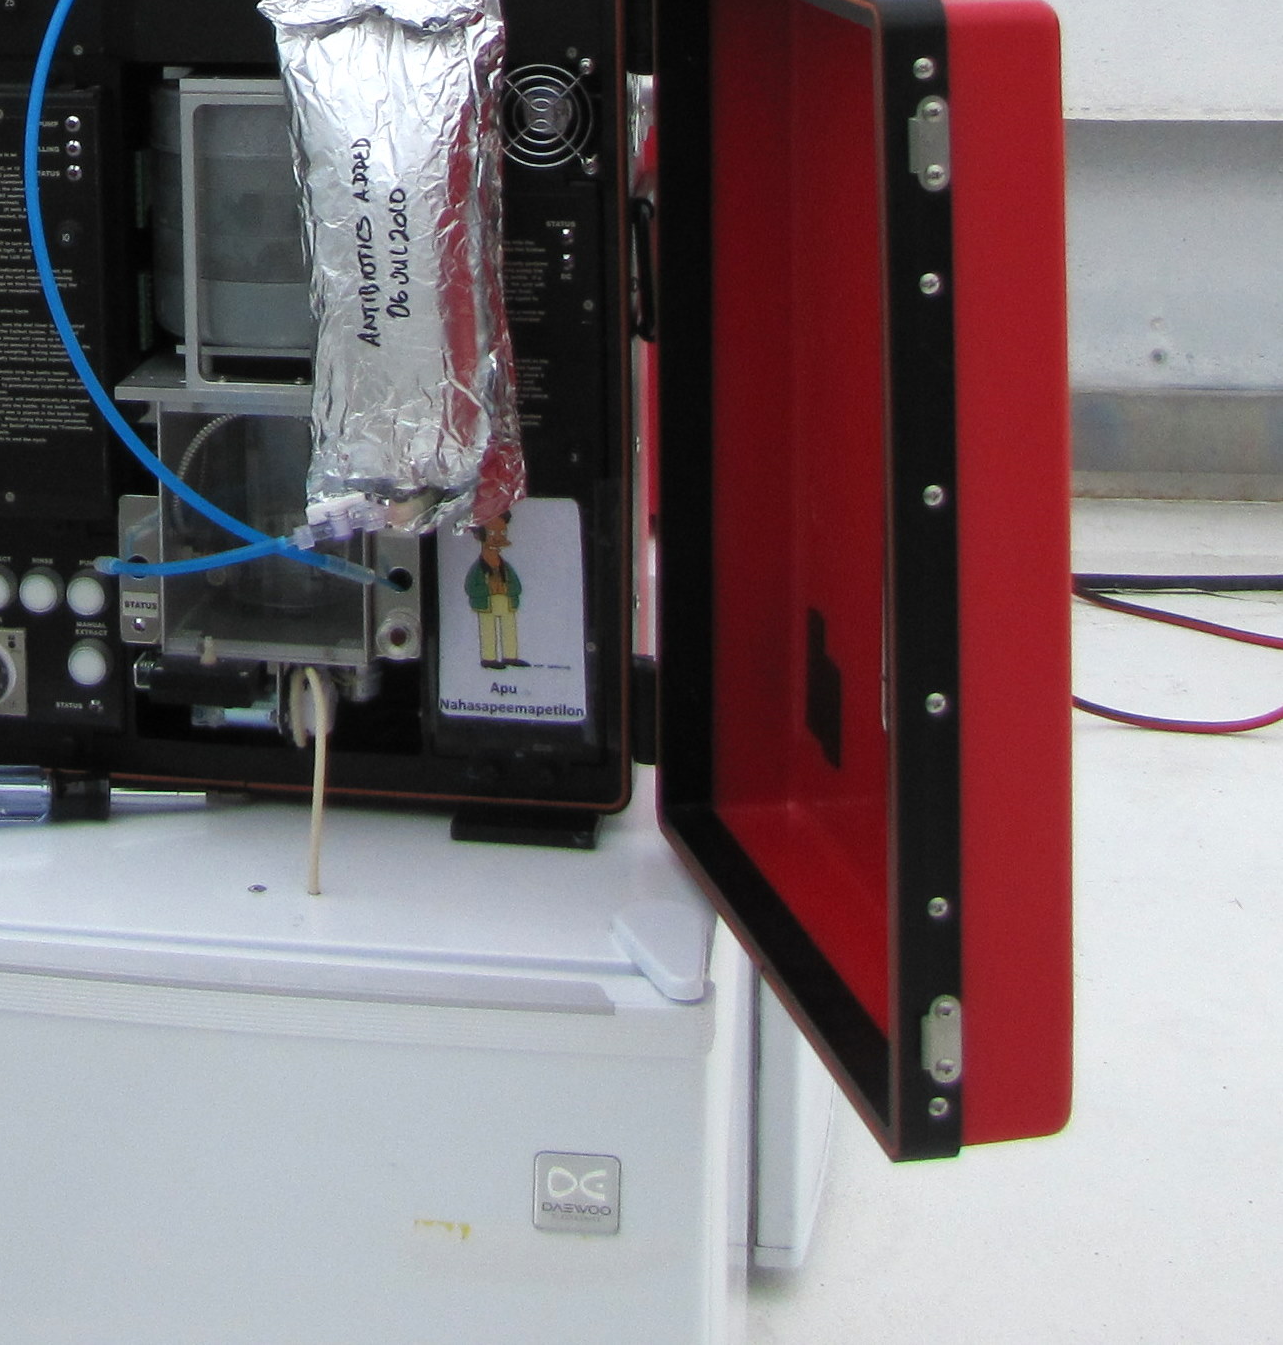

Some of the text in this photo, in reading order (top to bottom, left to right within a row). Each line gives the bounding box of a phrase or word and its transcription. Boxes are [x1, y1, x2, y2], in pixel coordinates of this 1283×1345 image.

[352, 137, 381, 347] ANTIBIOTICS ADDED
[386, 188, 411, 319] 06 JUL 2010
[32, 557, 53, 565] RINSE
[125, 601, 157, 609] STATUS
[490, 682, 517, 700] Apu
[56, 701, 83, 709] STATUS
[440, 699, 585, 717] Nahasapeemapetilon
[542, 1202, 611, 1215] DAEWOO
